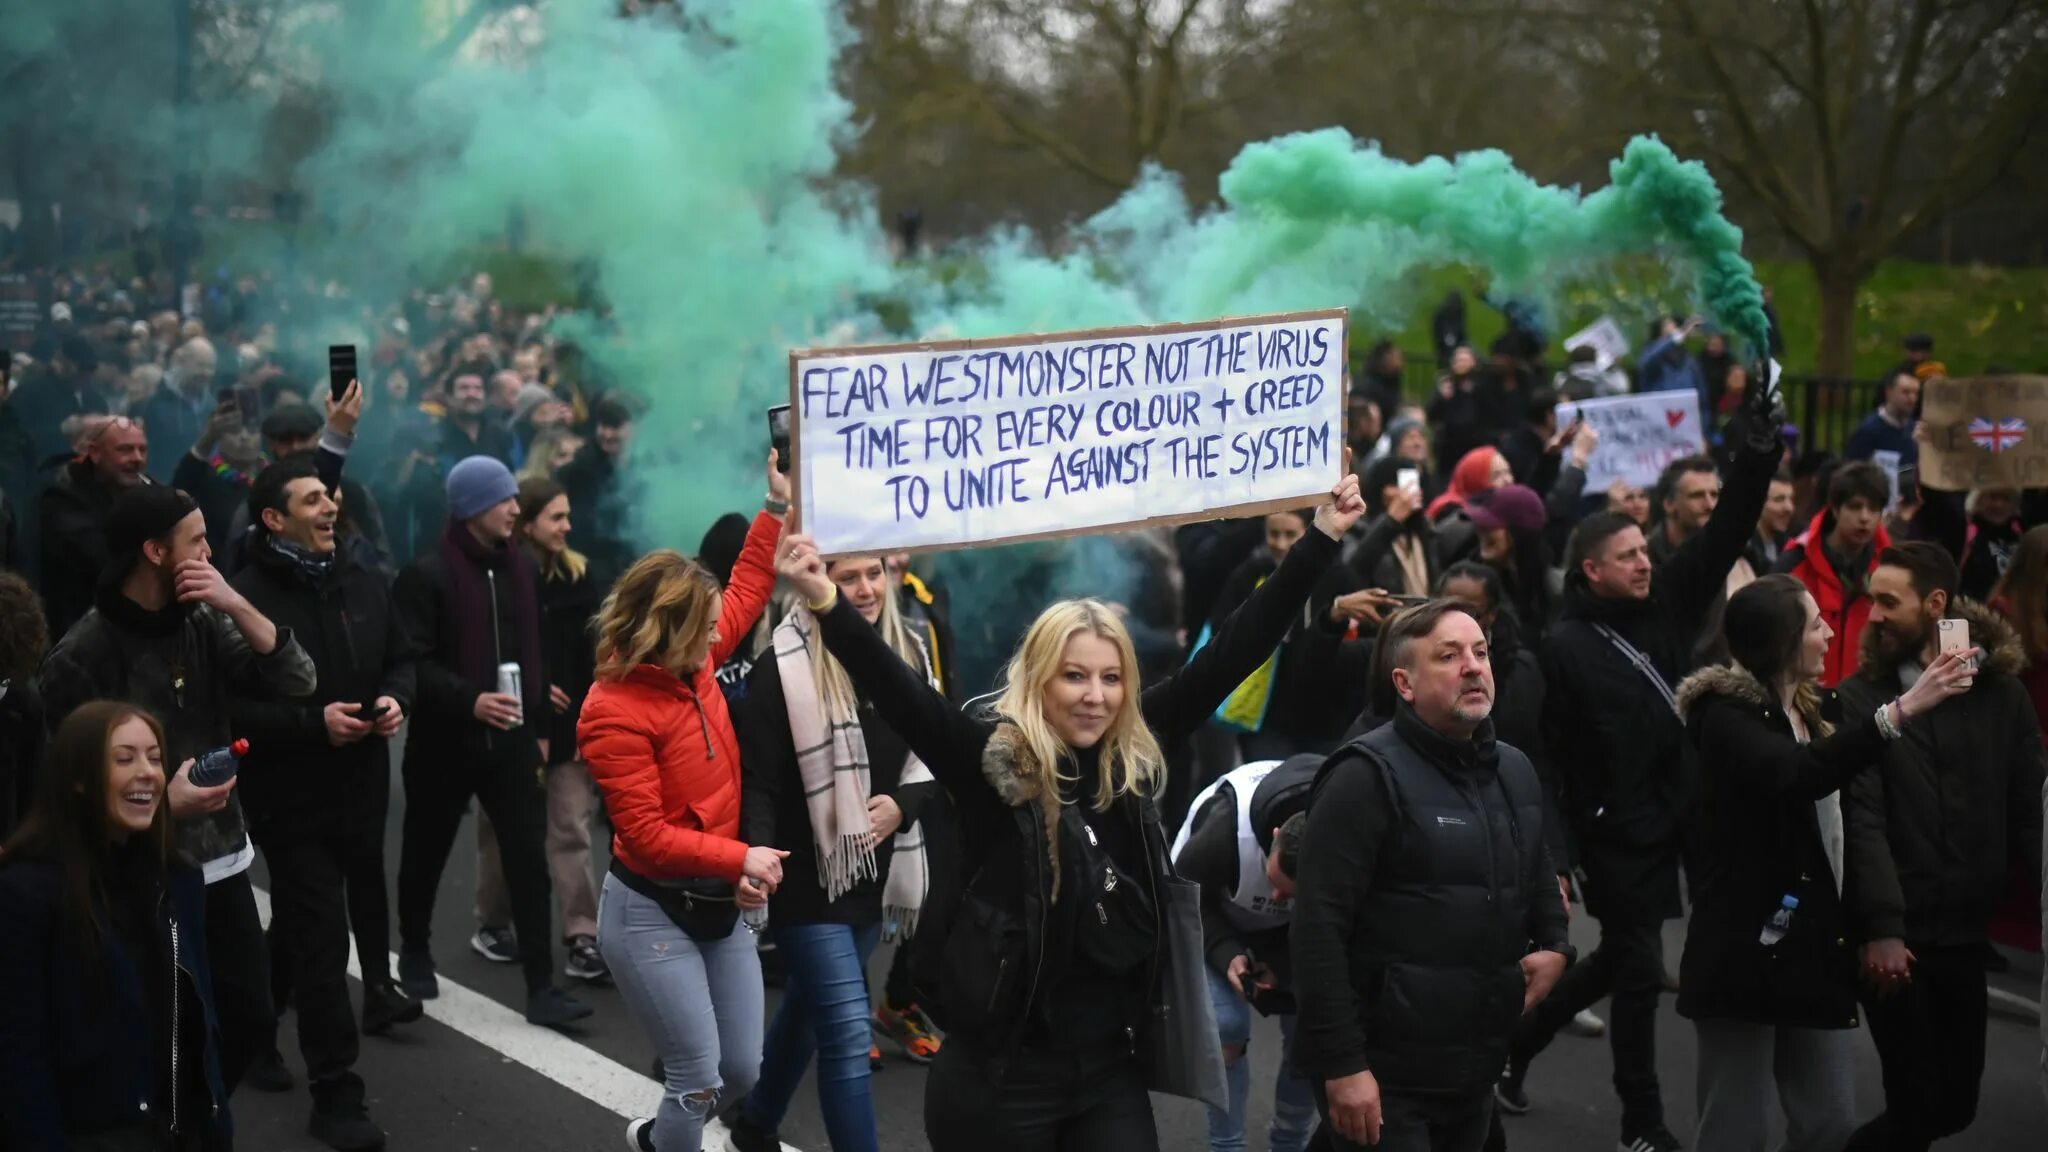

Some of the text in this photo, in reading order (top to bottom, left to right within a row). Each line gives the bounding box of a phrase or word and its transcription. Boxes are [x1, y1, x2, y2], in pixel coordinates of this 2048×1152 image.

[803, 327, 1329, 419] FEAR WESTMONSTER NOT THE VIRUS
[835, 373, 1325, 469] TIME FOR EVERY COLOUR + CREED
[885, 421, 1330, 522] TO UNITE AGAINST THE SYSTEM
